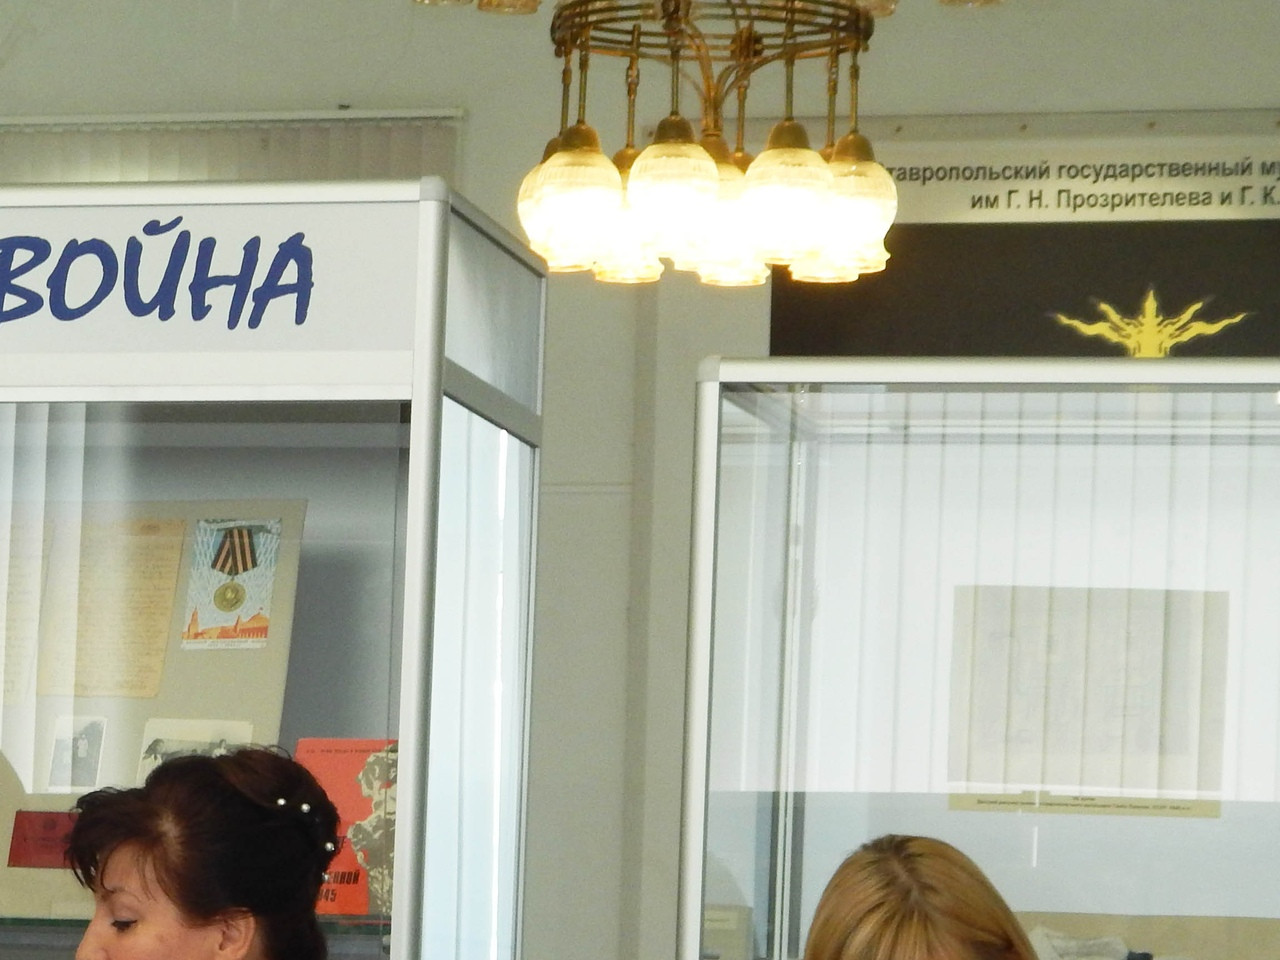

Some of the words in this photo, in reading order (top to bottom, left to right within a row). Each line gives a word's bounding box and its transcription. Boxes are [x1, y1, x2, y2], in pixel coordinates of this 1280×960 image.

[885, 160, 1051, 186] тавропольский
[1058, 156, 1254, 185] государственный
[971, 194, 1000, 210] им
[1007, 189, 1021, 209] Г.
[1029, 189, 1049, 209] Н.
[1057, 189, 1213, 214] Прозрителева
[1220, 191, 1233, 206] и
[1240, 185, 1255, 206] Г.
